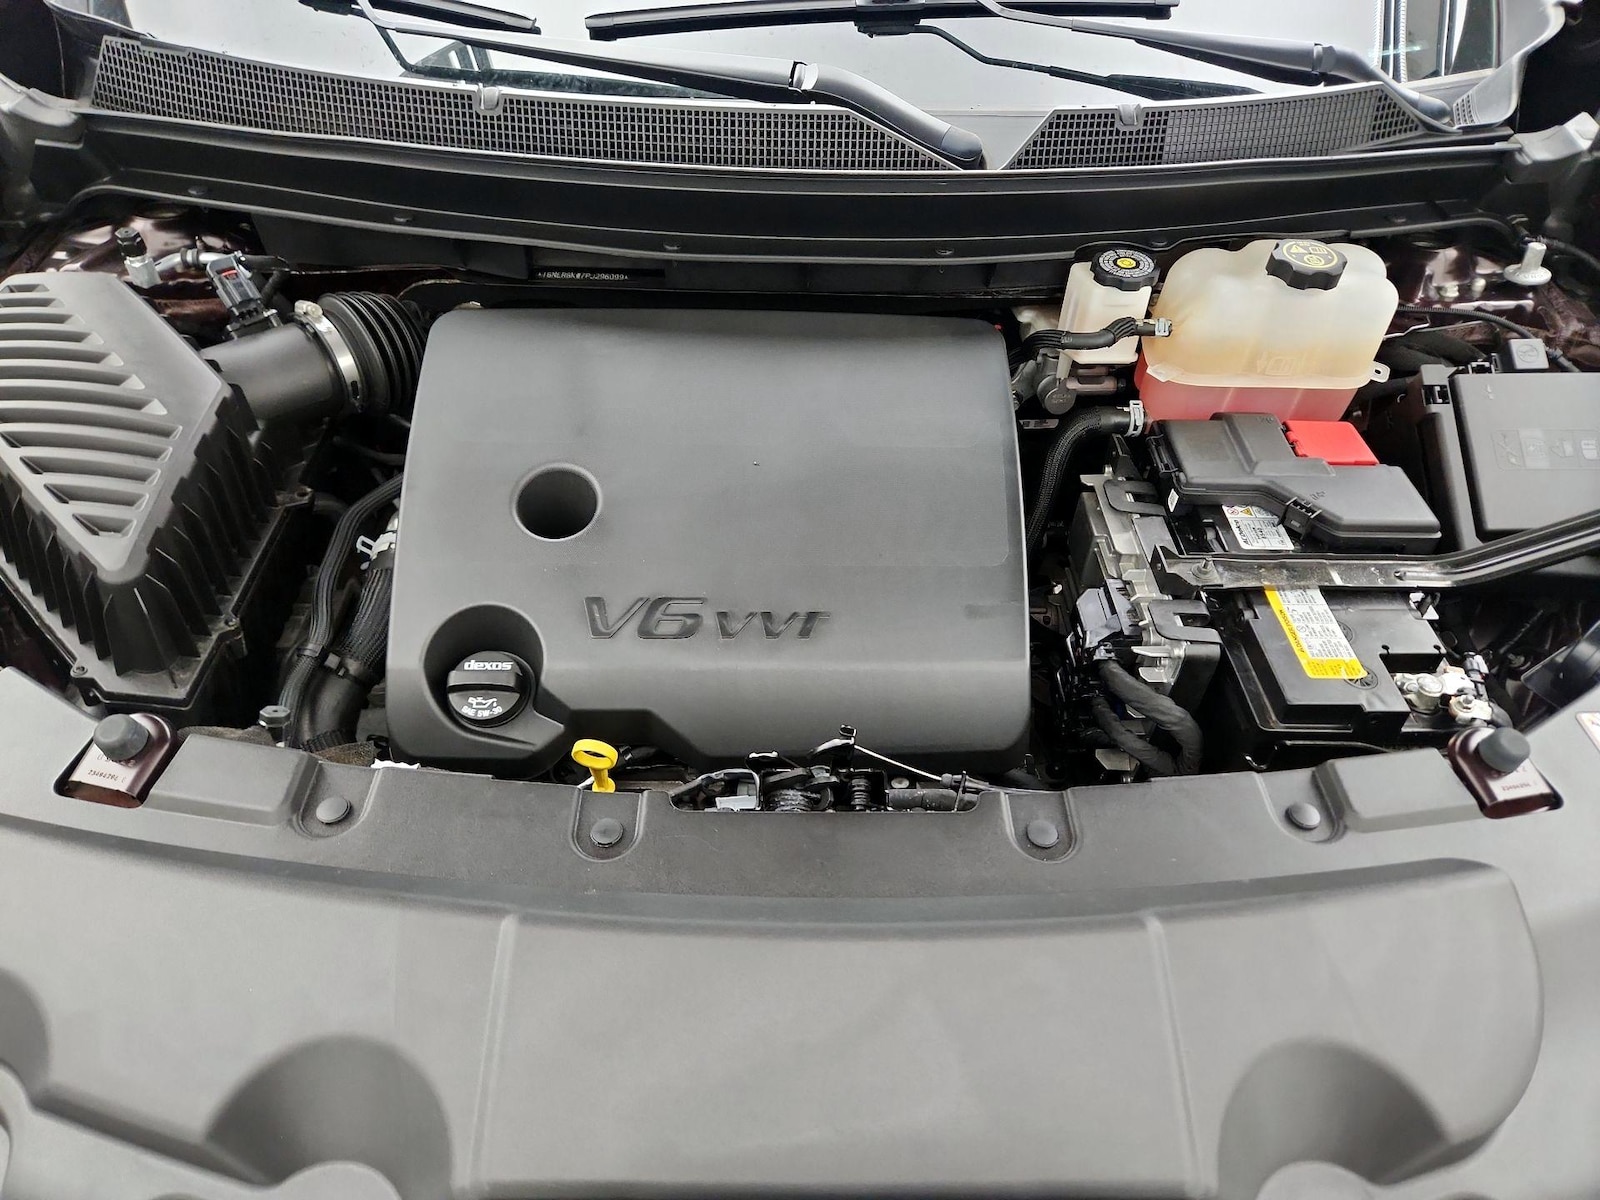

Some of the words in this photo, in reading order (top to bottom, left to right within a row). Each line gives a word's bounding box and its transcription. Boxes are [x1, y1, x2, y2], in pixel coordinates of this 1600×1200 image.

[583, 596, 708, 640] V6
[463, 660, 514, 671] dexos
[476, 705, 503, 717] 5W-30
